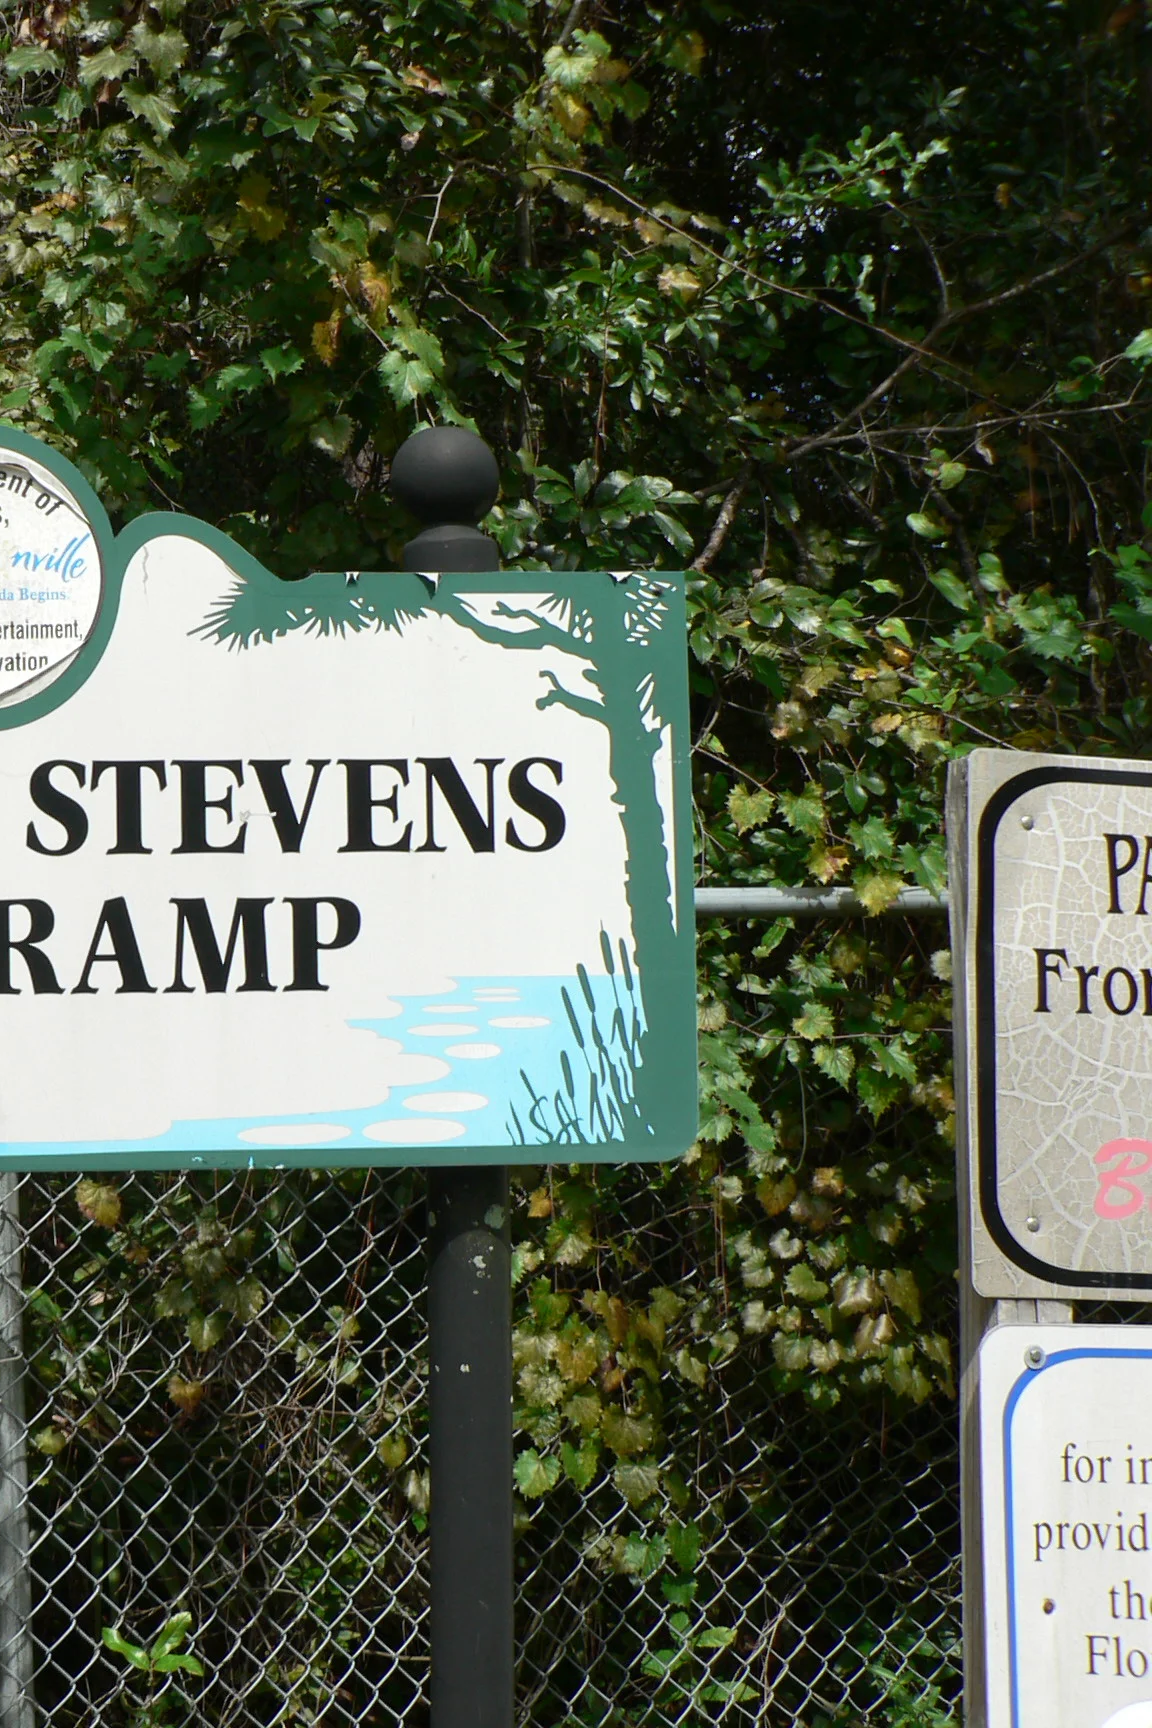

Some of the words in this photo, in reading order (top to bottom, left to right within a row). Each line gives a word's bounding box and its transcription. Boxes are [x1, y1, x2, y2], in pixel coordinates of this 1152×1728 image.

[35, 492, 64, 517] of
[26, 757, 566, 857] STEVENS
[1033, 948, 1152, 1017] Fro
[1093, 1137, 1152, 1220] B
[1061, 1443, 1112, 1484] for
[1034, 1511, 1150, 1562] provid
[1109, 1580, 1152, 1621] th
[1085, 1635, 1152, 1678] Flo
